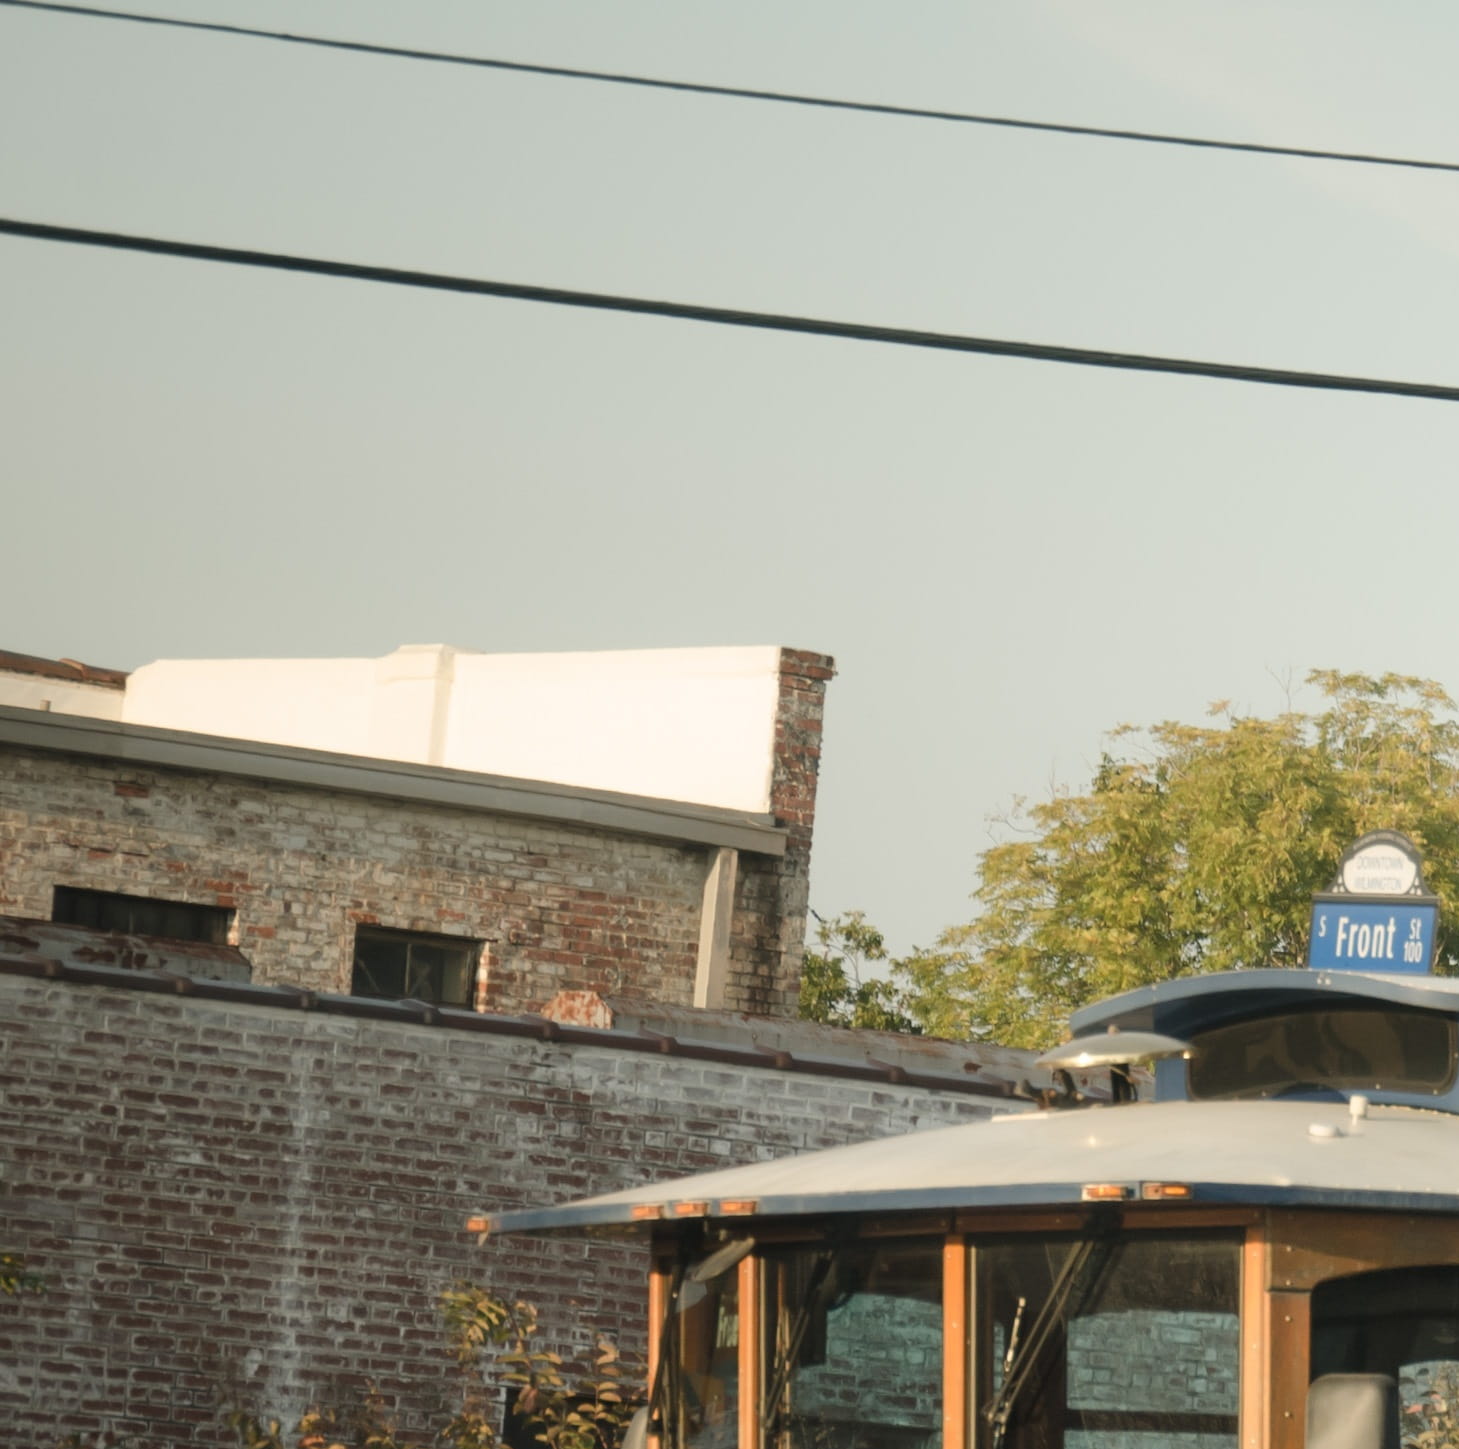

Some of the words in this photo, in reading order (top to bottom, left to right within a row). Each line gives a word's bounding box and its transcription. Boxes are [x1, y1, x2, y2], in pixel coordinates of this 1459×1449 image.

[1318, 915, 1327, 938] S
[1335, 916, 1396, 959] Front
[1410, 918, 1422, 940] St
[1404, 941, 1423, 963] 100
